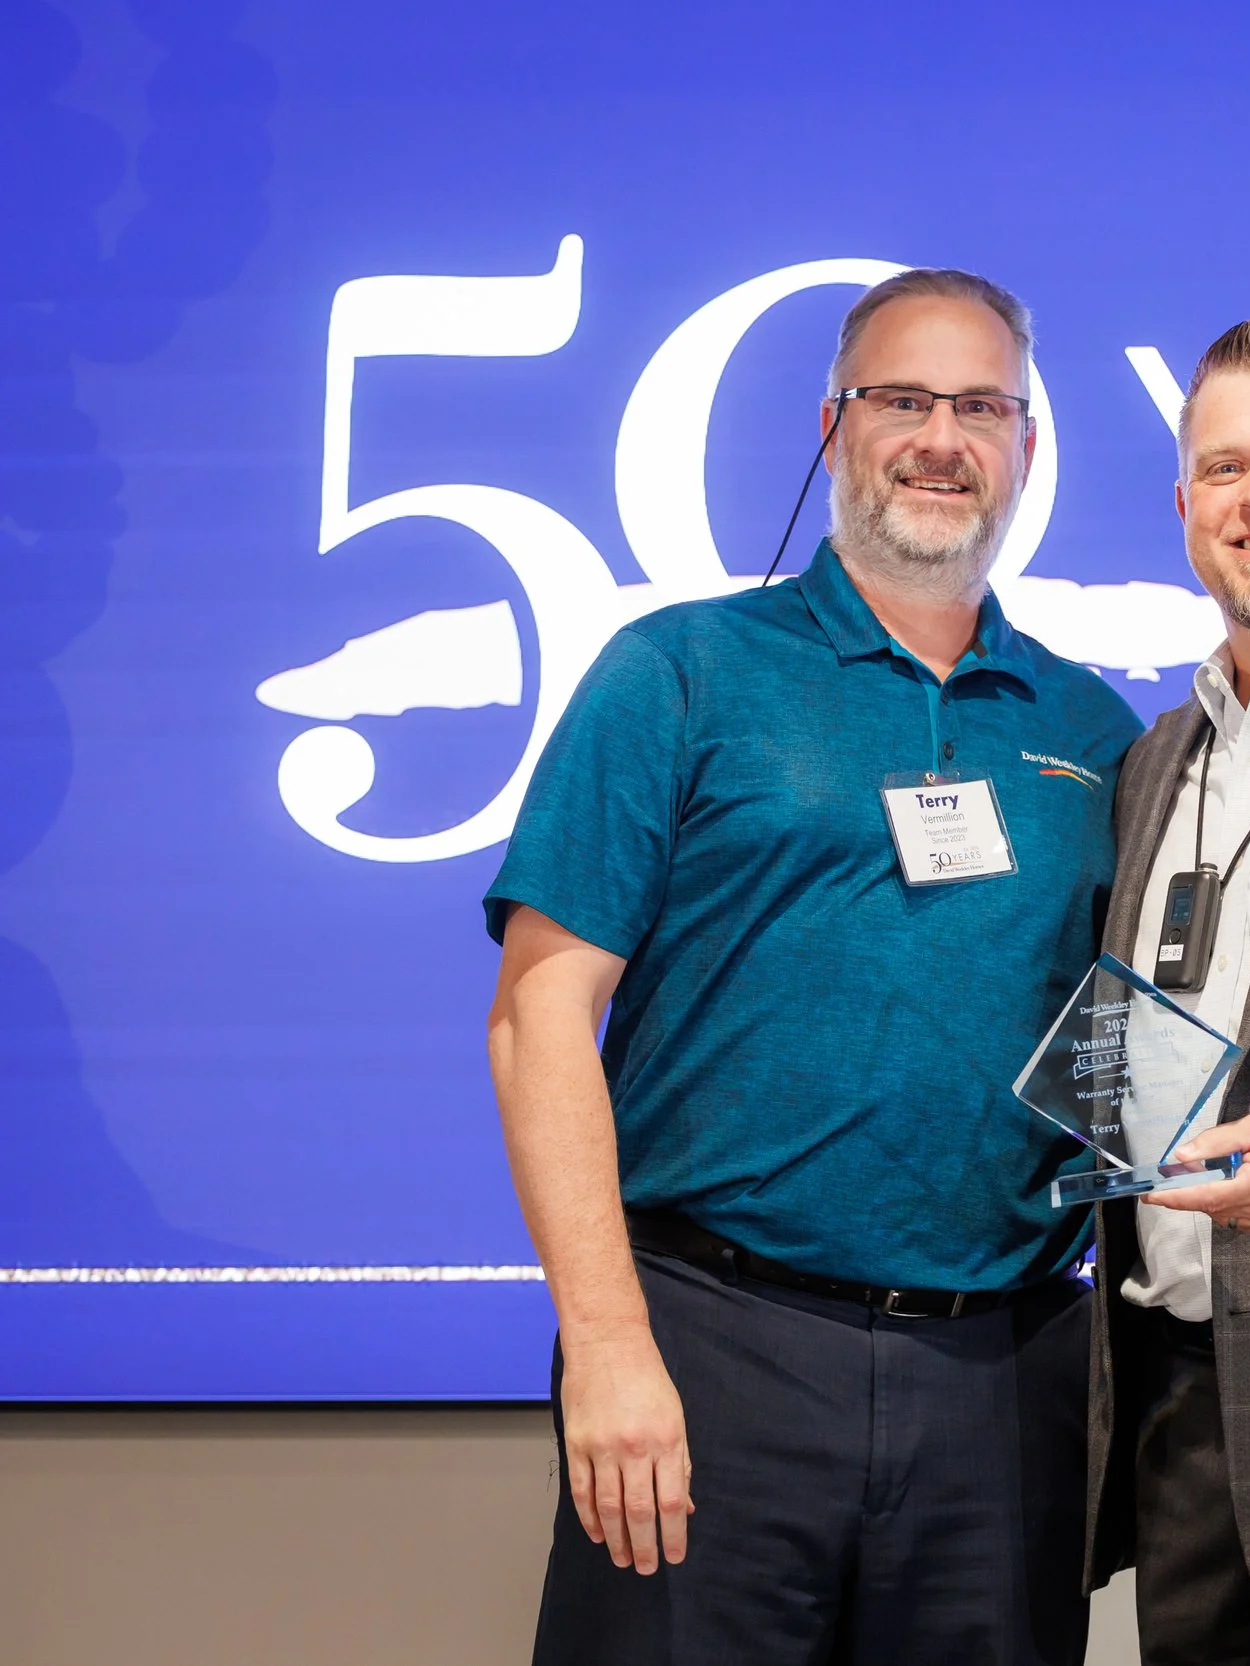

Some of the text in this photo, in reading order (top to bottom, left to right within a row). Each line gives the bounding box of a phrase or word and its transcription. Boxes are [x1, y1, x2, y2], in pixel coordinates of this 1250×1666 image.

[278, 234, 1058, 862] 50
[1021, 751, 1047, 764] David
[915, 794, 958, 810] Terry
[920, 812, 965, 825] Vermillion
[924, 826, 968, 837] Team Member
[931, 836, 949, 844] Since
[929, 850, 982, 874] 50 YEARS
[1079, 1001, 1129, 1015] David Weekley
[1070, 1033, 1121, 1053] Annual
[1076, 1088, 1115, 1100] Warranty
[1110, 1098, 1119, 1107] of
[1090, 1123, 1120, 1135] Terry
